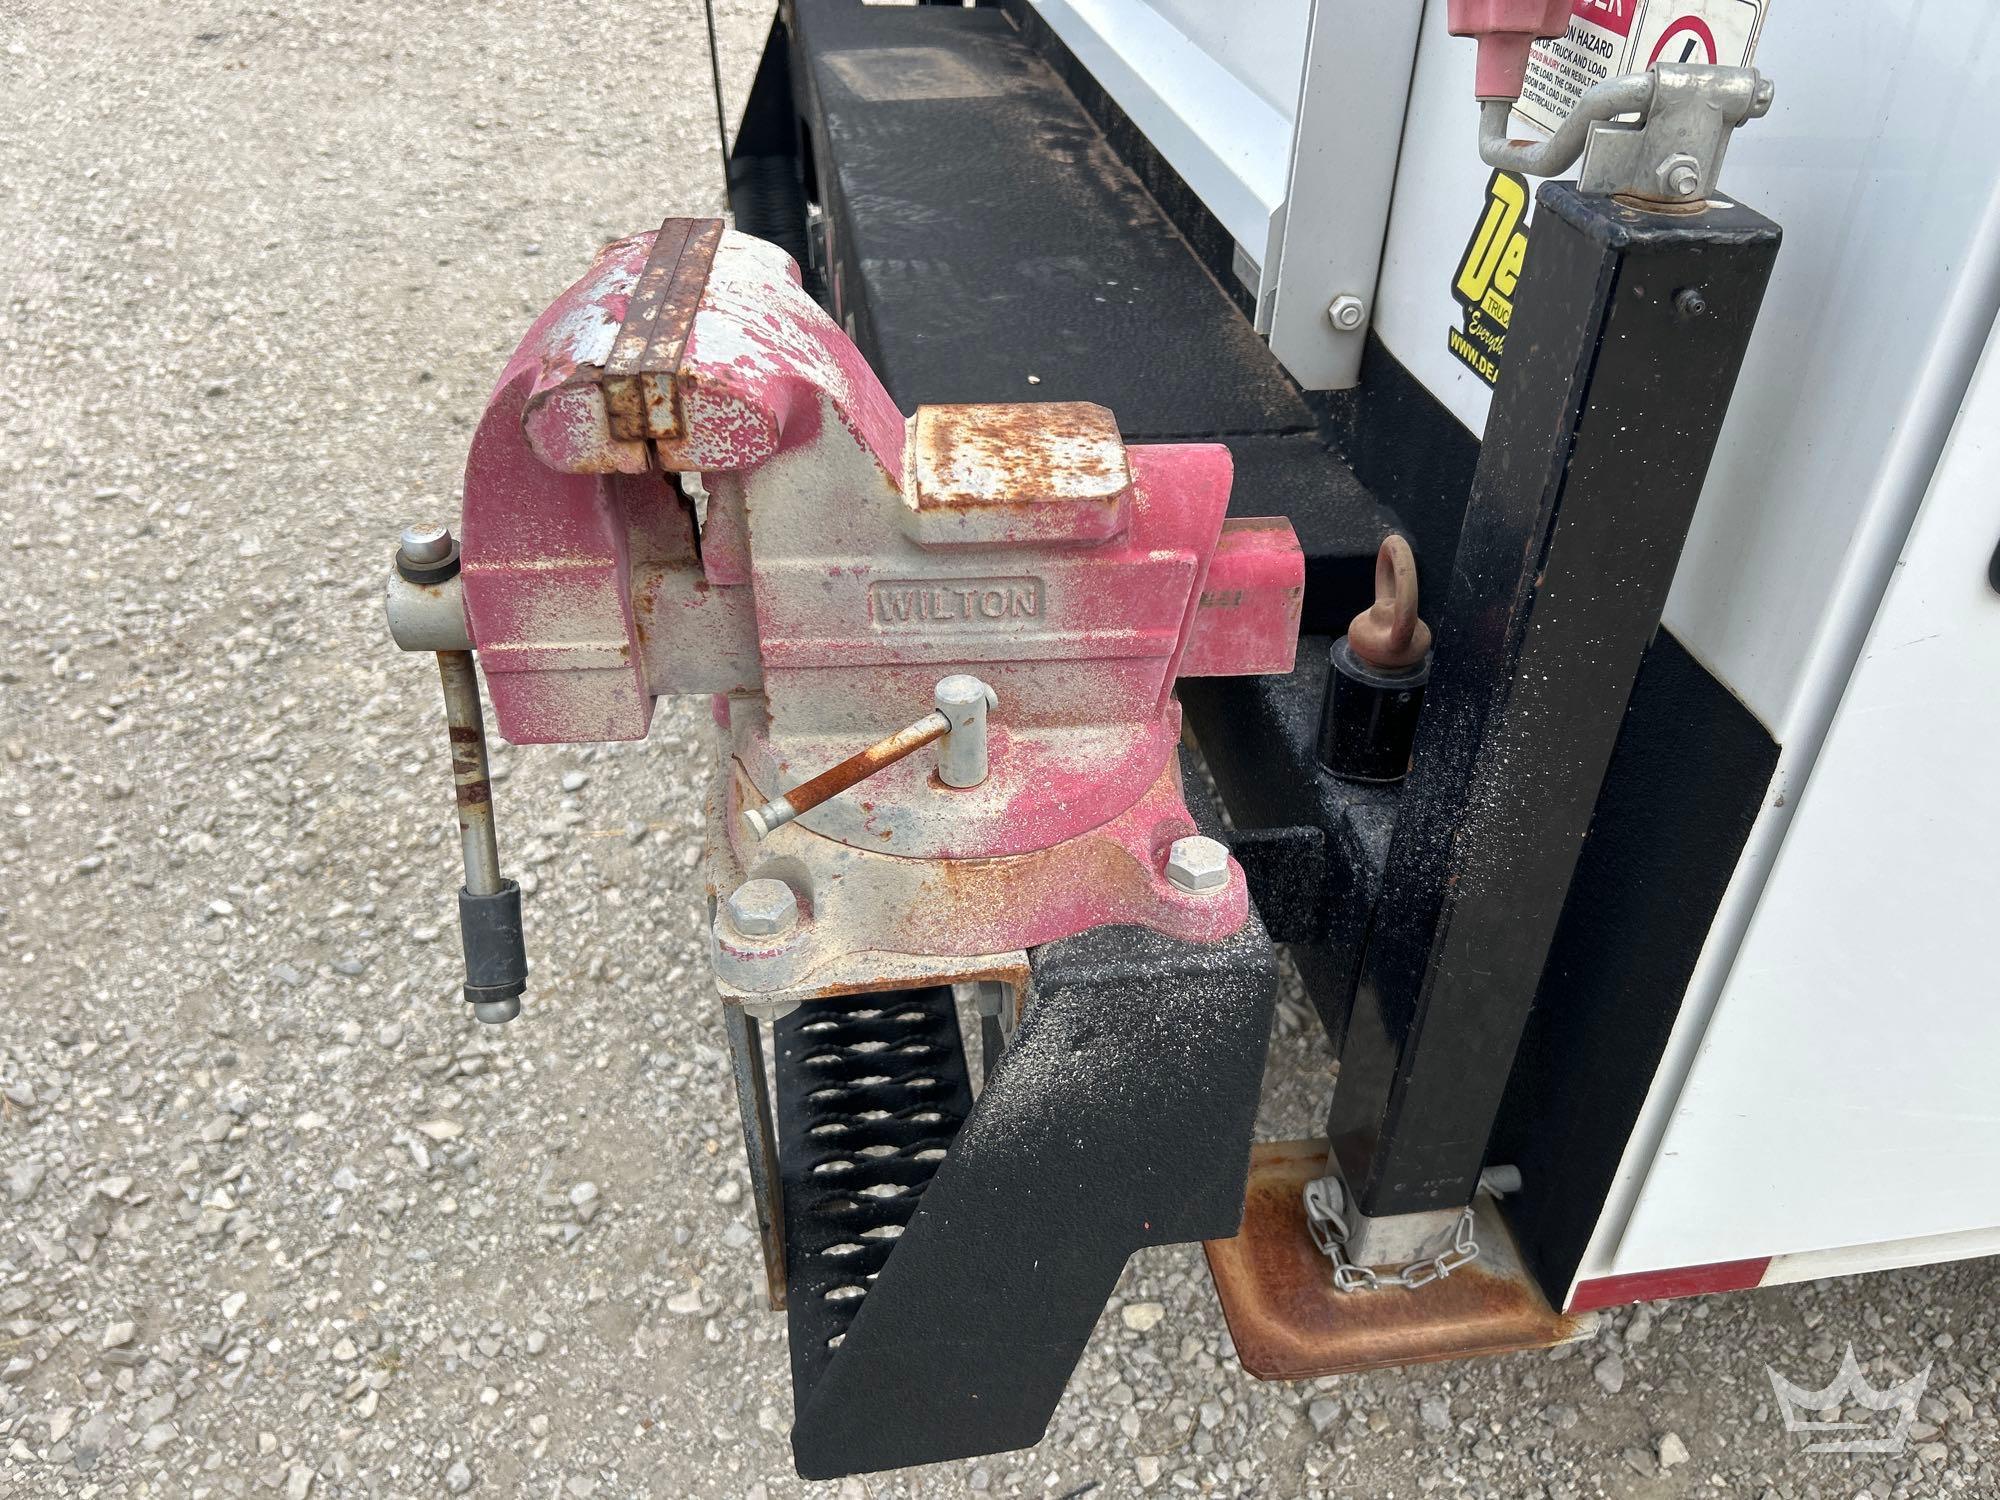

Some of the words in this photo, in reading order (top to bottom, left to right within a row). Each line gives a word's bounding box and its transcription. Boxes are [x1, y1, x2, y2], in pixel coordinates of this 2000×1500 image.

[1576, 29, 1614, 58] HAZARD
[1552, 42, 1573, 62] TRUCK
[1572, 53, 1587, 69] AND
[1587, 60, 1607, 78] LOAD
[1530, 63, 1540, 75] THE
[1554, 76, 1565, 88] THE
[1564, 82, 1583, 98] CRANE
[1560, 65, 1572, 77] CAN
[1572, 70, 1591, 87] RESULT
[1523, 88, 1556, 113] ELECTRICALLY
[1555, 107, 1570, 119] CHA
[1538, 81, 1546, 92] OR
[1545, 86, 1560, 100] LOAD
[1559, 94, 1571, 107] LINE
[1487, 299, 1510, 324] TRUC
[878, 589, 1038, 622] WILTON
